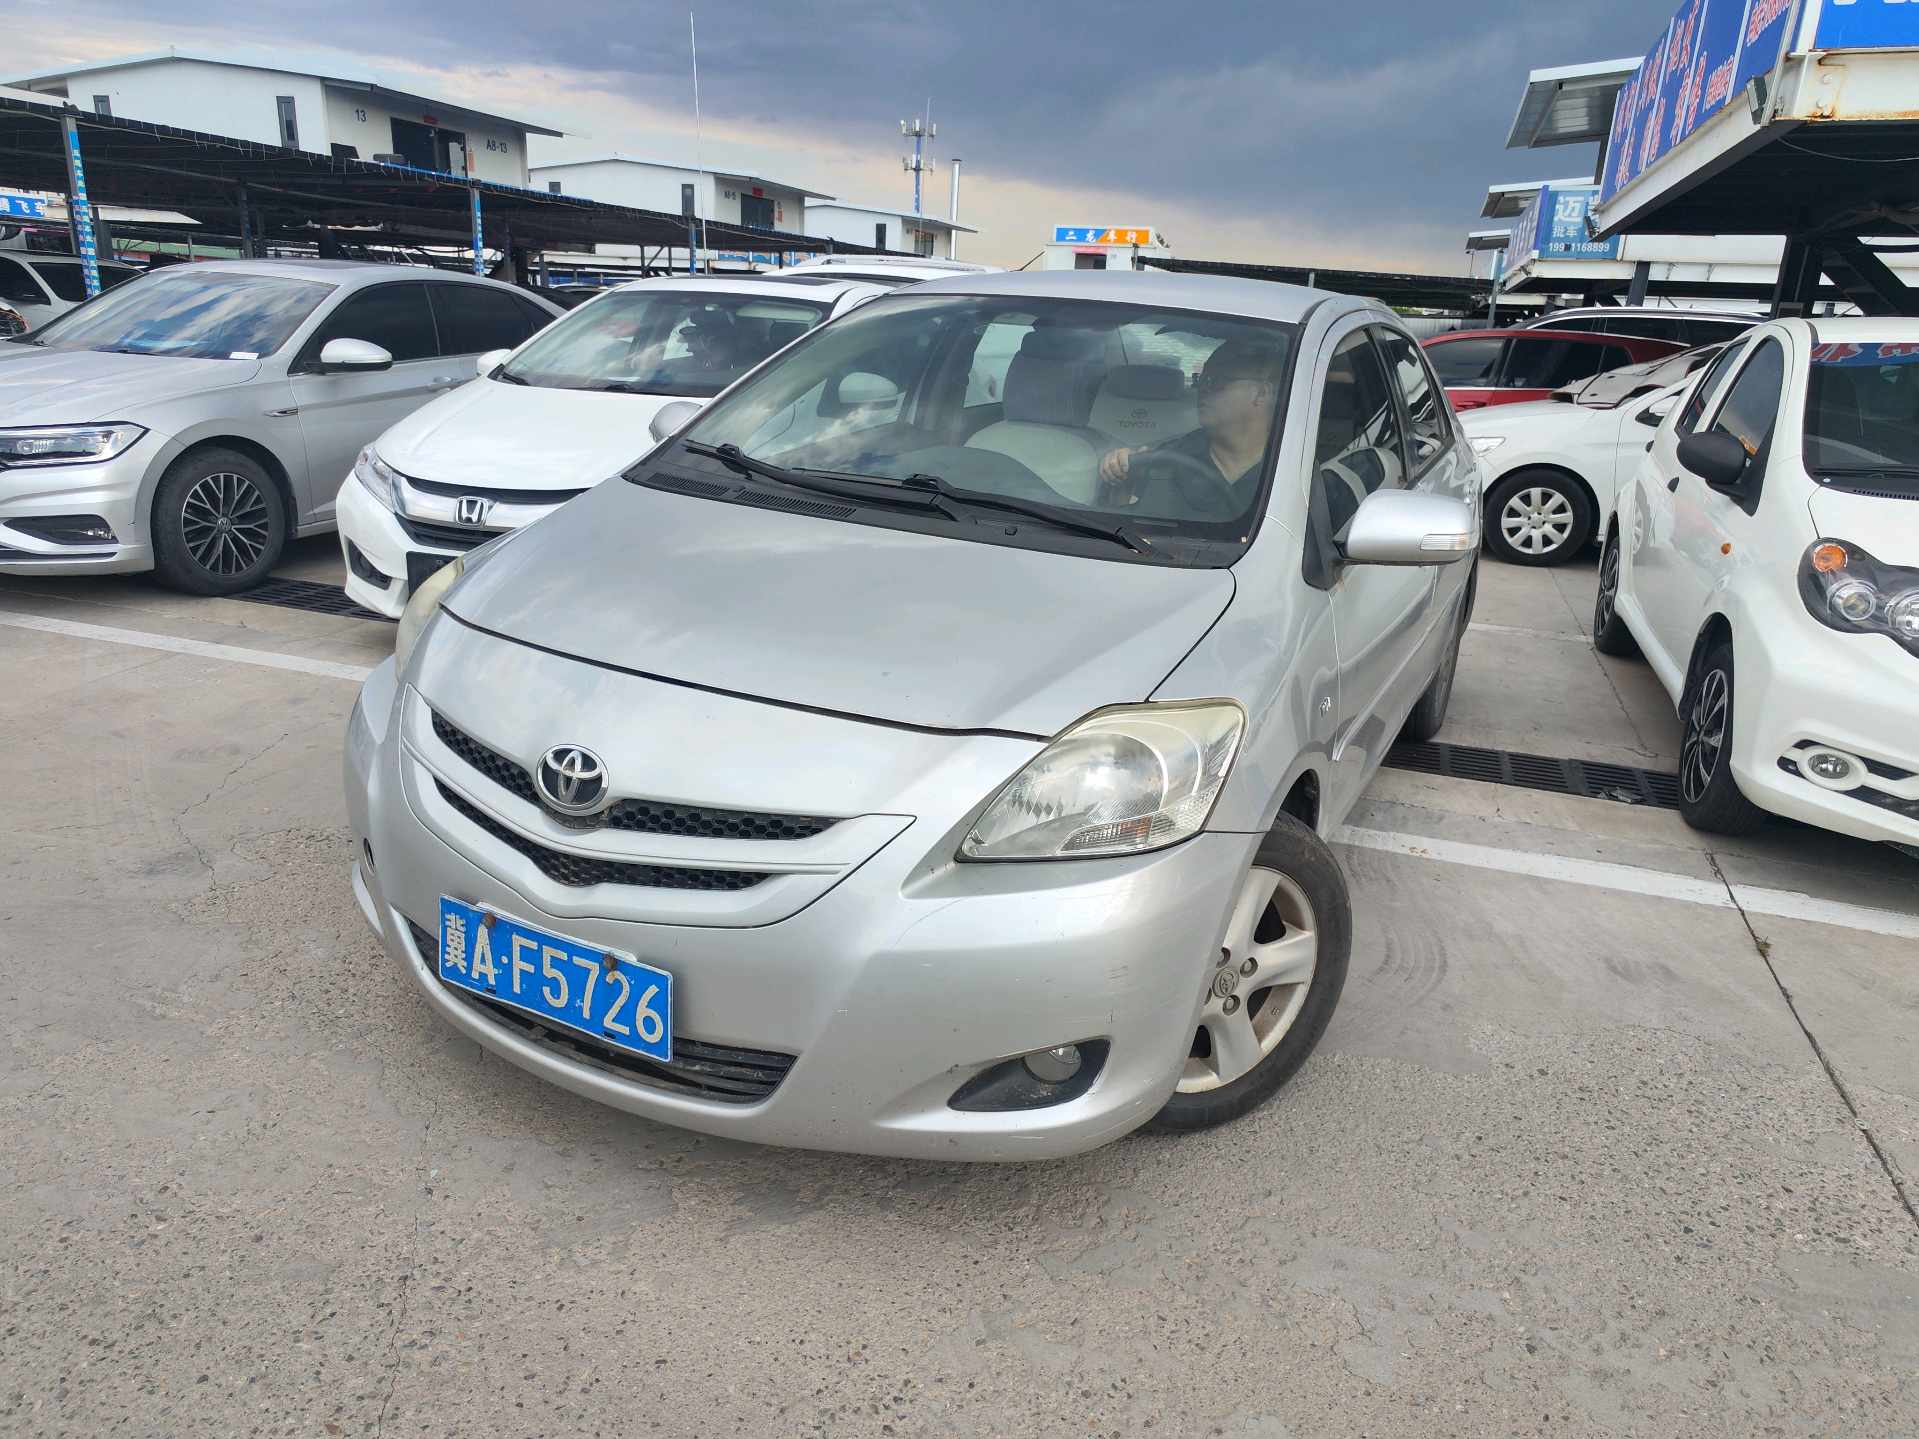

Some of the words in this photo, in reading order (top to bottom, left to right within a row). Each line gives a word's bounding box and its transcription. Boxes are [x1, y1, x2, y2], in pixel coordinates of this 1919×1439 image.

[355, 108, 367, 122] 13
[486, 138, 508, 153] A8-13
[1065, 229, 1136, 243] 二龙车行
[1549, 242, 1610, 253] 1991168899
